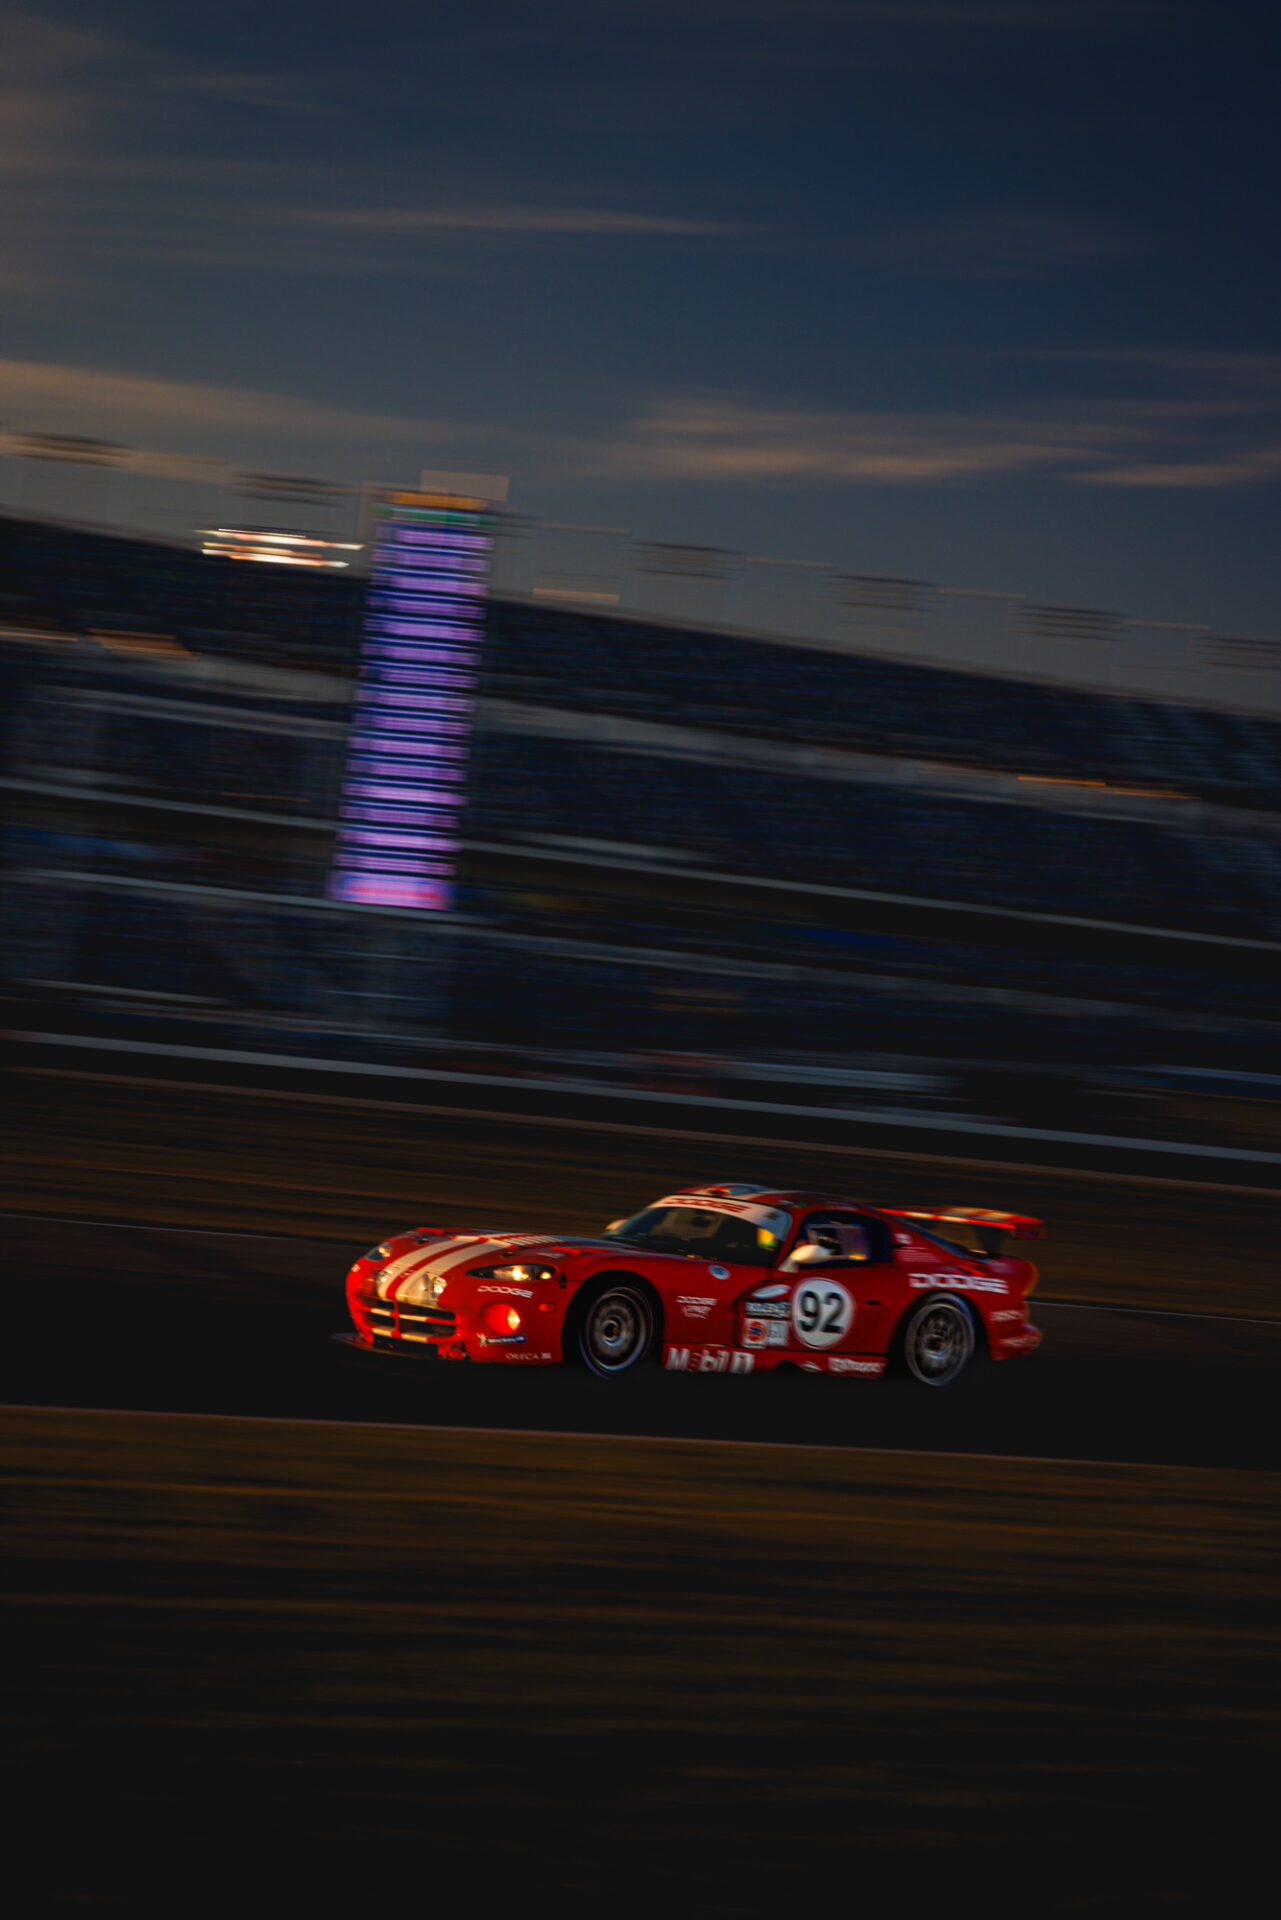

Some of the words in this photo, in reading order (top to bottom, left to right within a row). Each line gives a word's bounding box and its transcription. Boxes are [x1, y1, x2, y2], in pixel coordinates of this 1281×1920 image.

[477, 1285, 534, 1299] DODGE
[907, 1273, 1009, 1294] DODGE
[798, 1290, 845, 1333] 92
